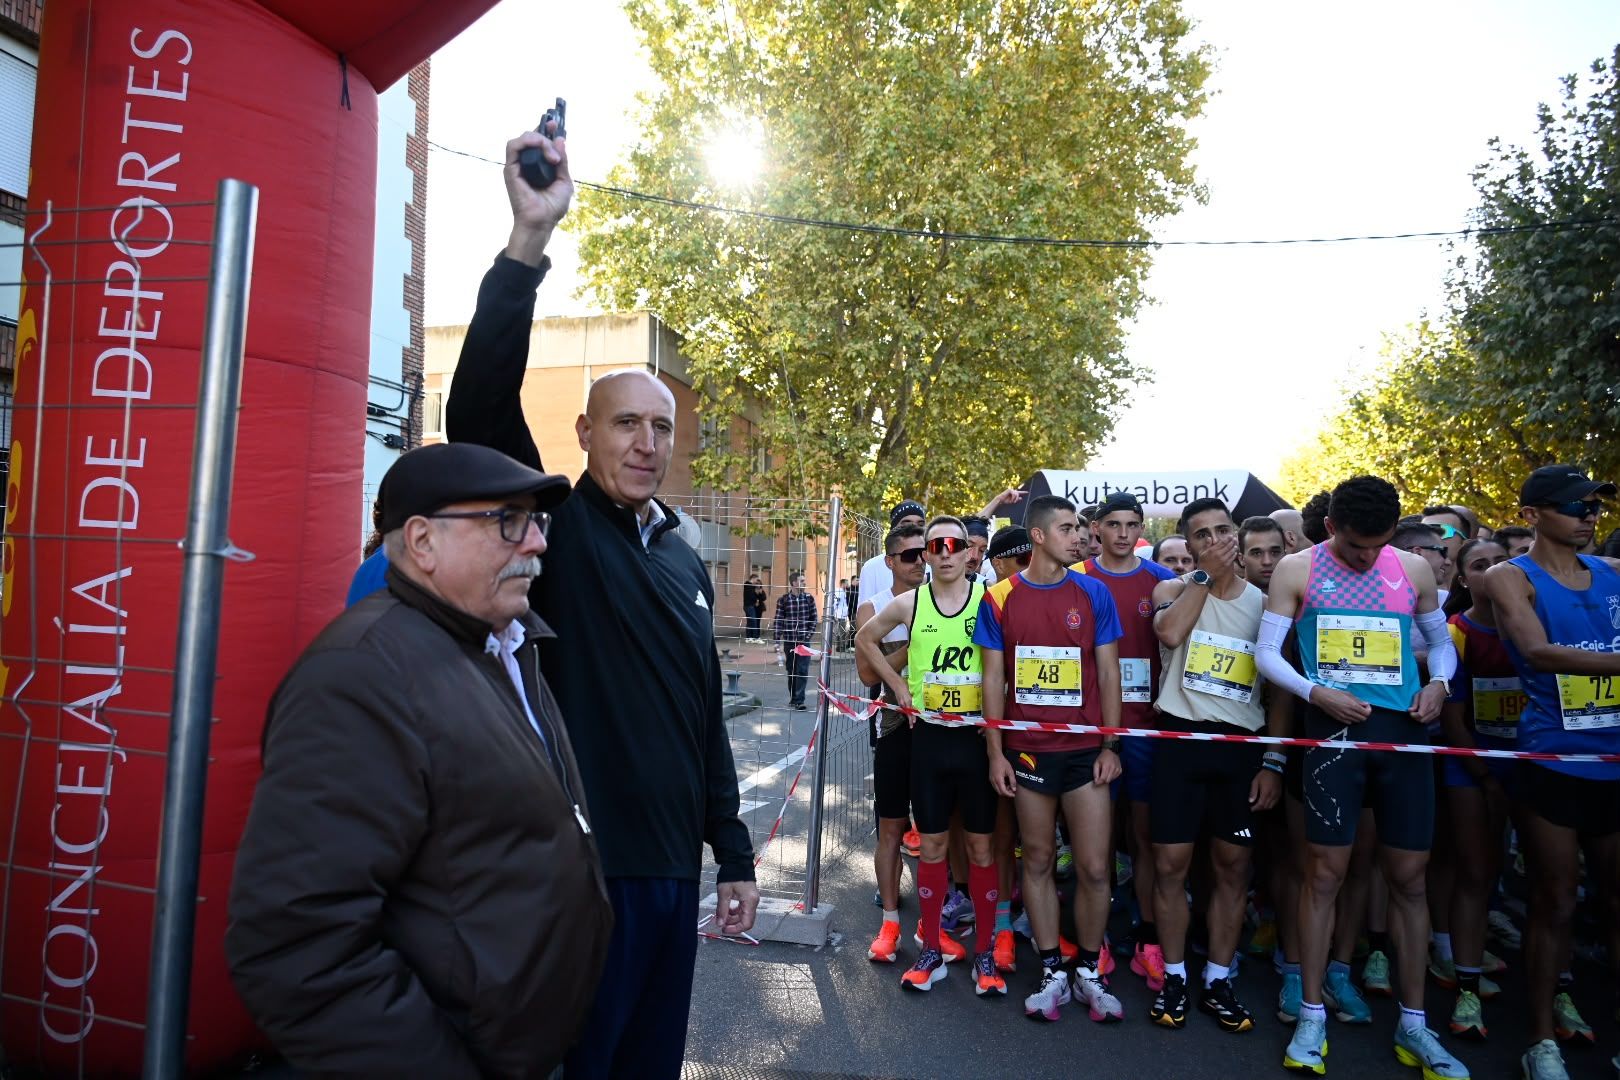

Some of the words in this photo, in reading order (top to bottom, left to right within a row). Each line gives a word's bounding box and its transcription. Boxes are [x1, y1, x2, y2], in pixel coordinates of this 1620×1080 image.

[92, 28, 193, 400] DEPORTES
[79, 436, 147, 530] DE
[1353, 636, 1365, 658] 9
[1553, 640, 1605, 653] rCaja
[931, 644, 974, 674] LRC
[1211, 652, 1236, 675] 37
[1037, 664, 1060, 684] 48
[941, 690, 961, 708] 26
[1589, 676, 1615, 700] 72
[41, 566, 133, 1043] CONCEJALÍA
